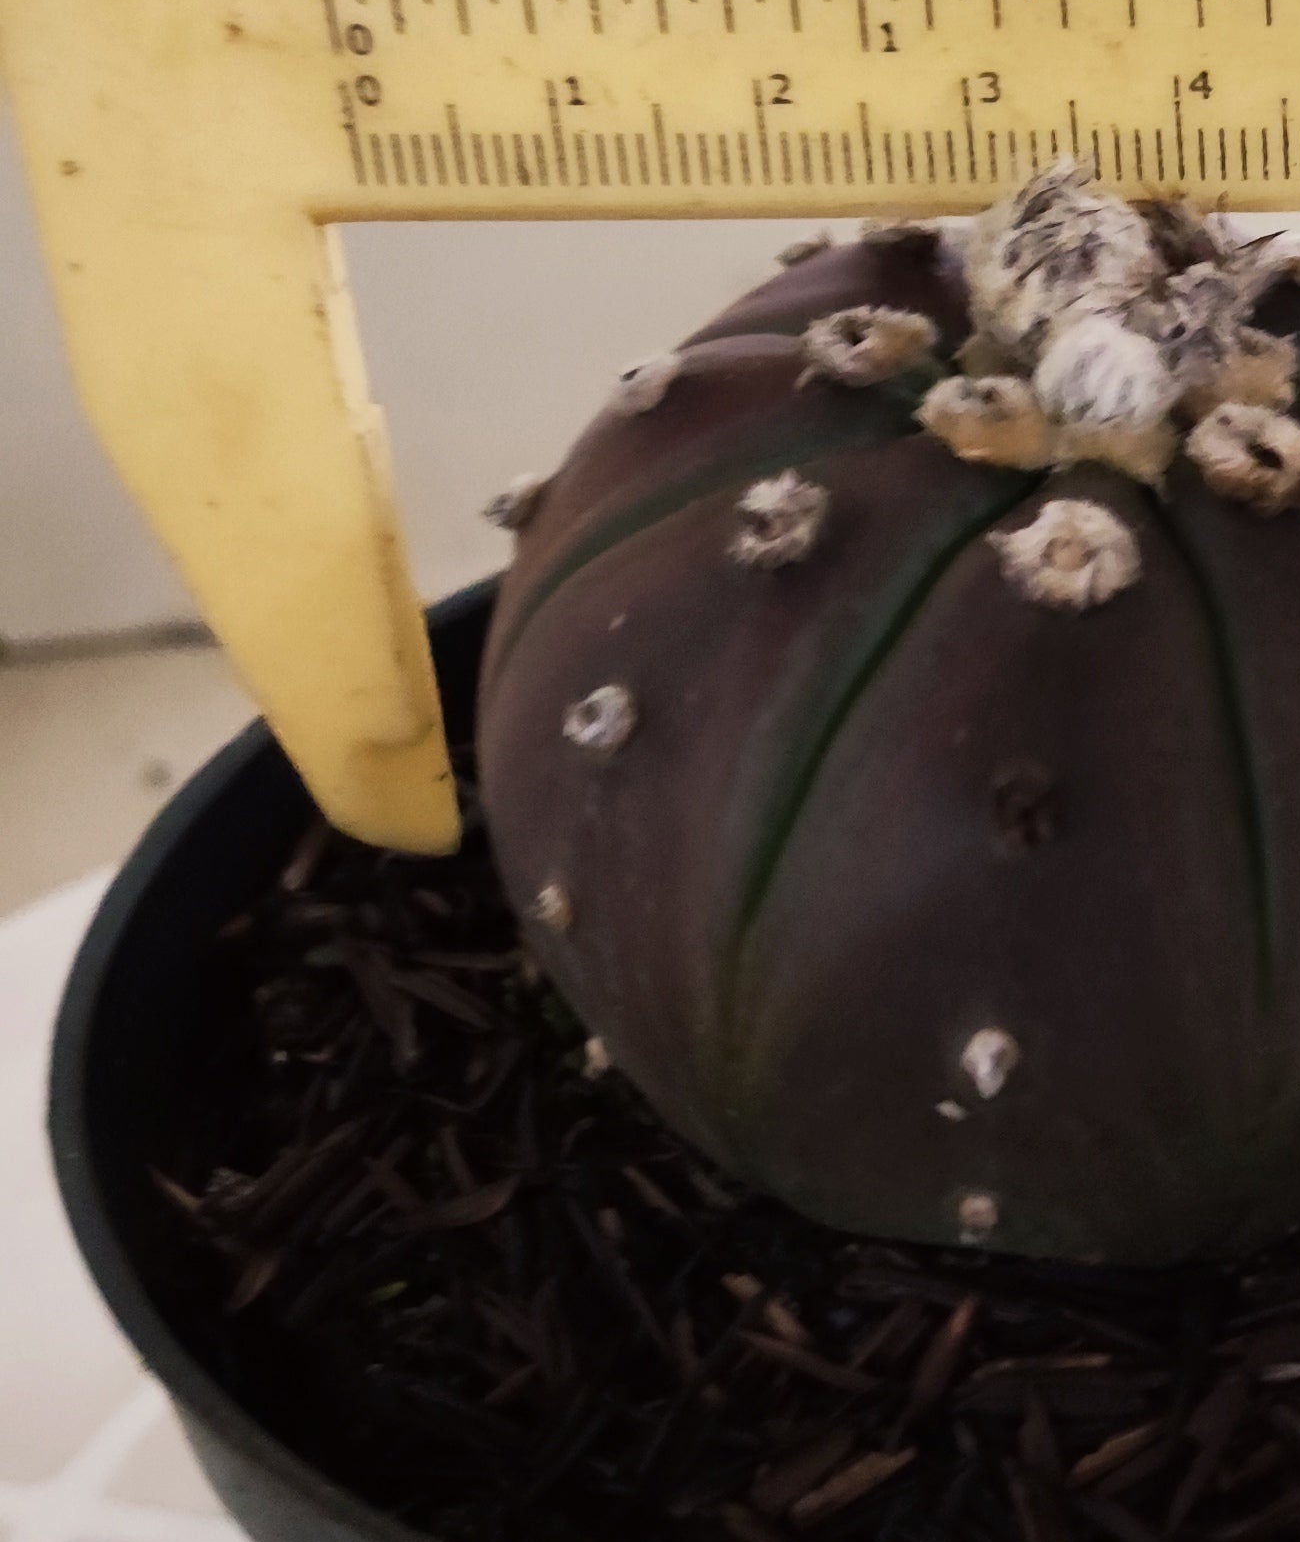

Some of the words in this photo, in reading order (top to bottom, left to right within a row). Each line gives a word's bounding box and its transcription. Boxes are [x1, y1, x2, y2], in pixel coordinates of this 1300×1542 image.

[346, 24, 373, 55] 0
[880, 23, 898, 52] 1
[356, 76, 382, 106] 0
[566, 77, 586, 106] 1
[770, 73, 793, 104] 2
[978, 72, 1001, 104] 3
[1189, 70, 1213, 99] 4
